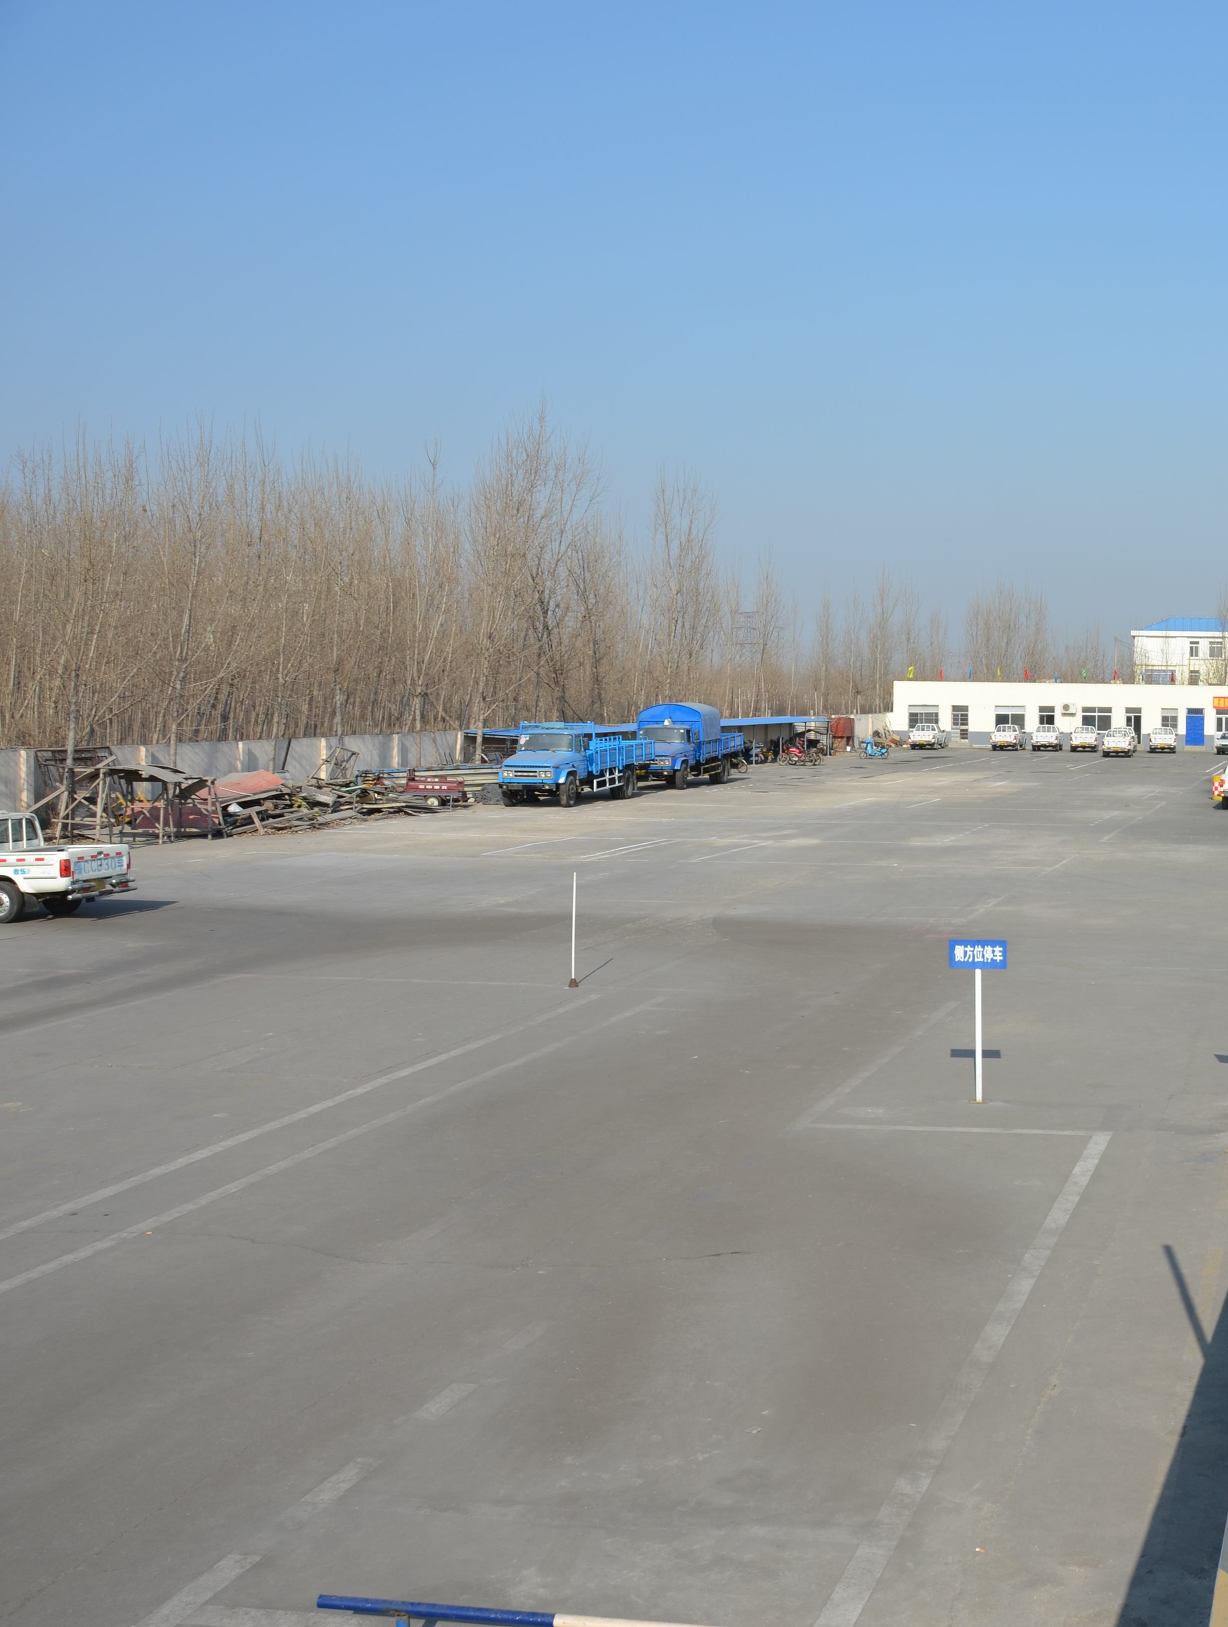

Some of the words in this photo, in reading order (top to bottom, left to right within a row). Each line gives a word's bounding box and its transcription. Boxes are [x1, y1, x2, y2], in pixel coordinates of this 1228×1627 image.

[954, 944, 1004, 963] 侧方位停车
